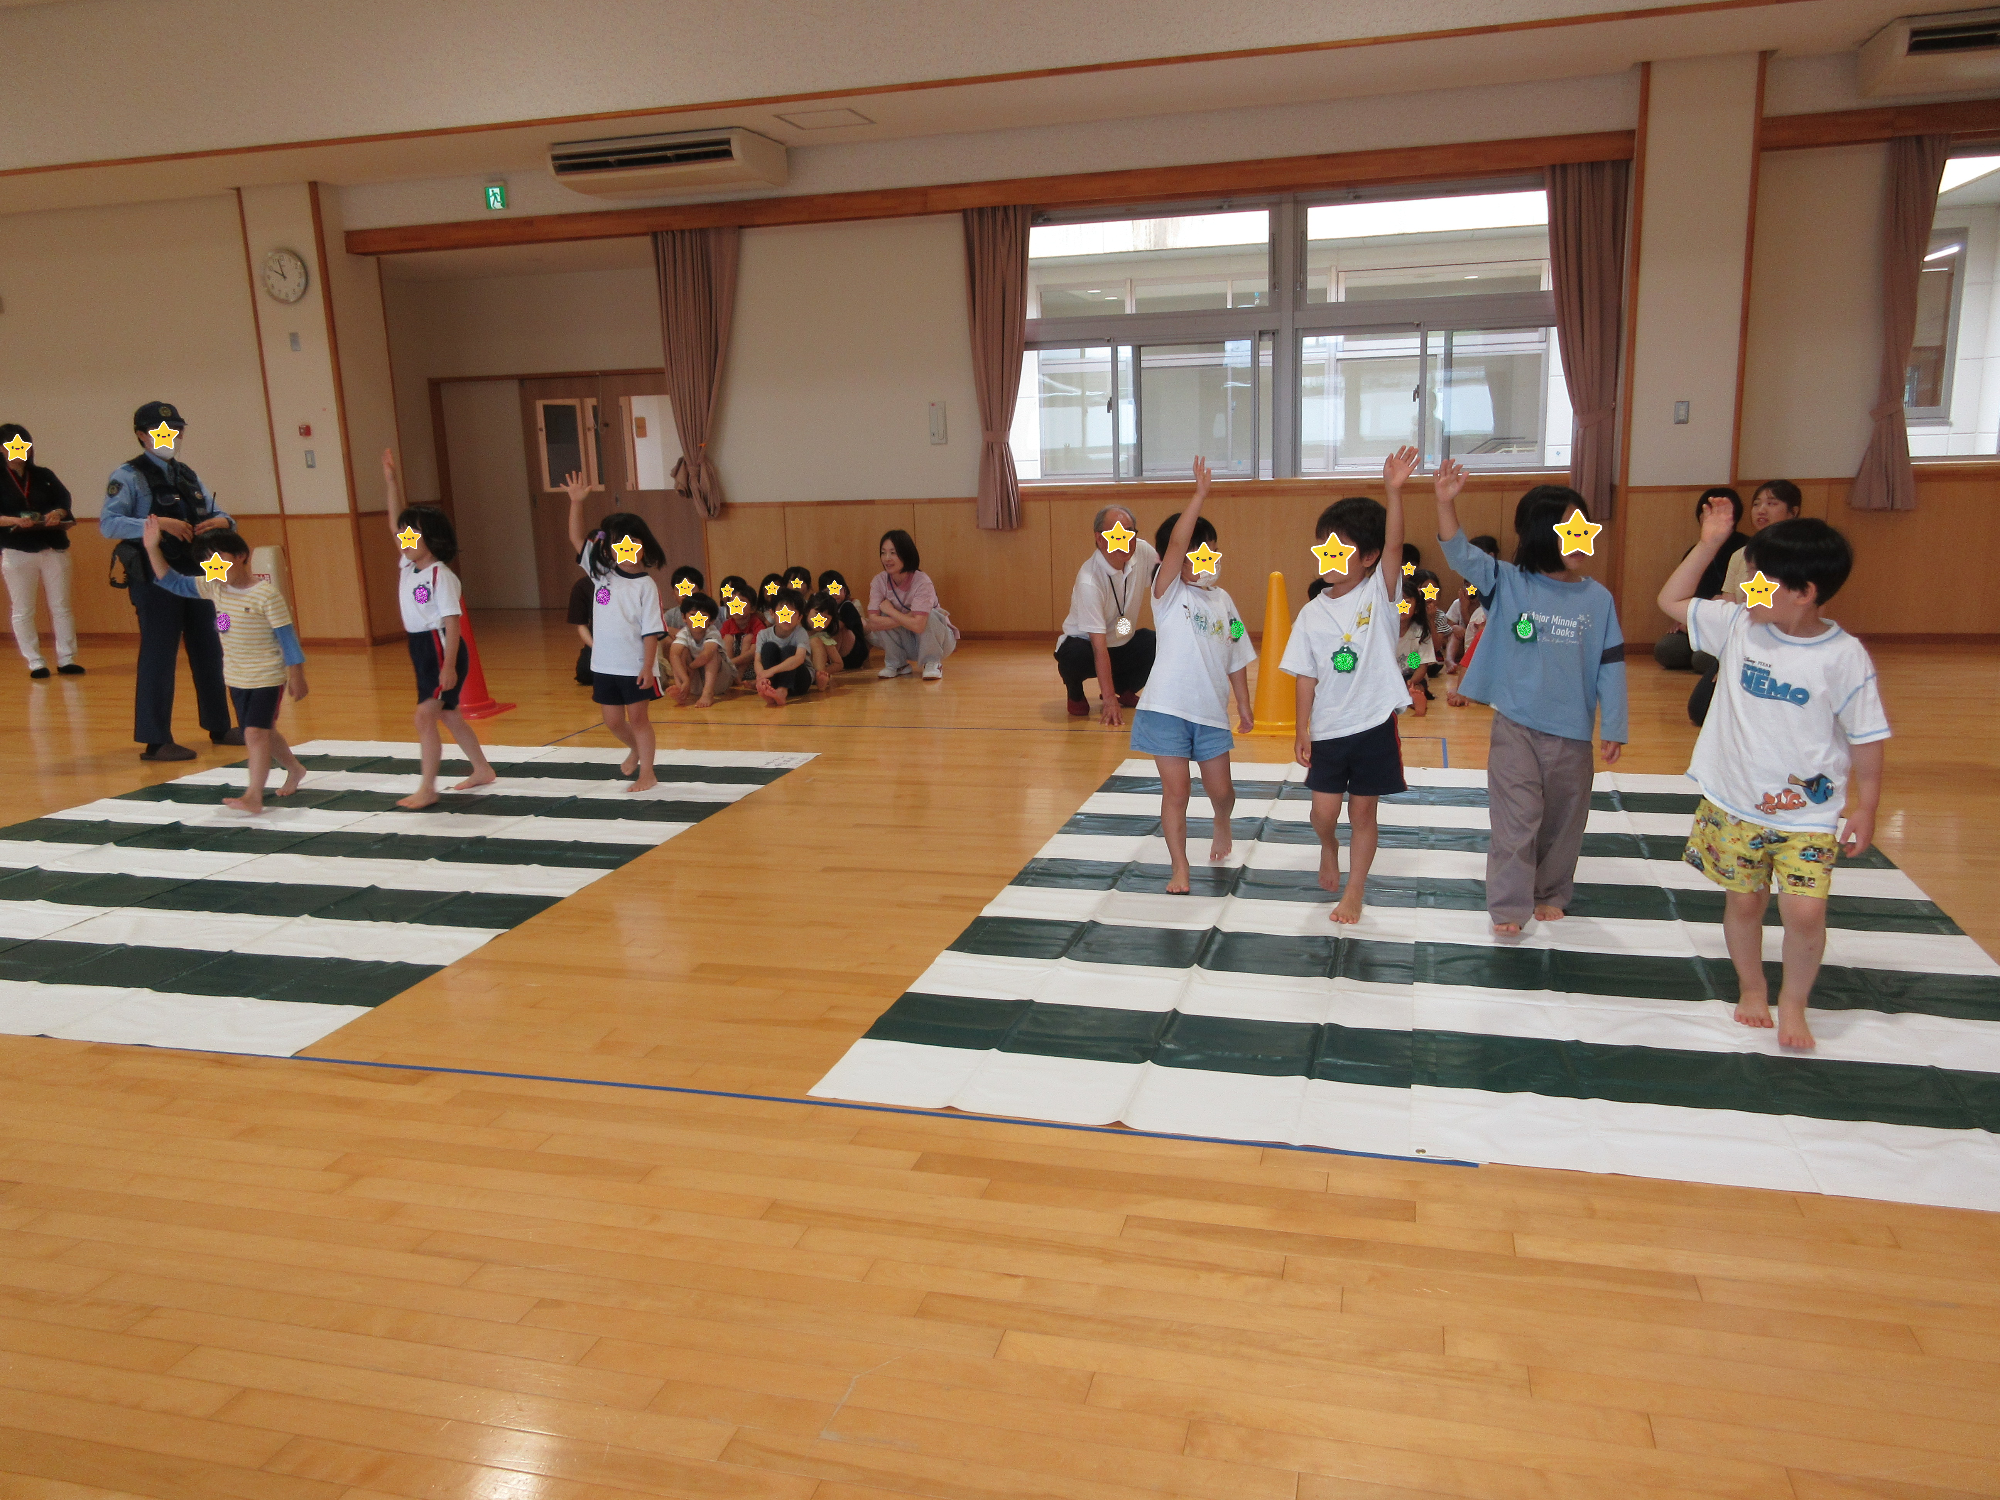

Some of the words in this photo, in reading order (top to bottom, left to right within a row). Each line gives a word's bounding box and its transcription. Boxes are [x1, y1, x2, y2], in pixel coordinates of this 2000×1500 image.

[1551, 614, 1578, 628] Minnie
[1551, 625, 1575, 638] Looks
[1741, 669, 1810, 706] NEMO
